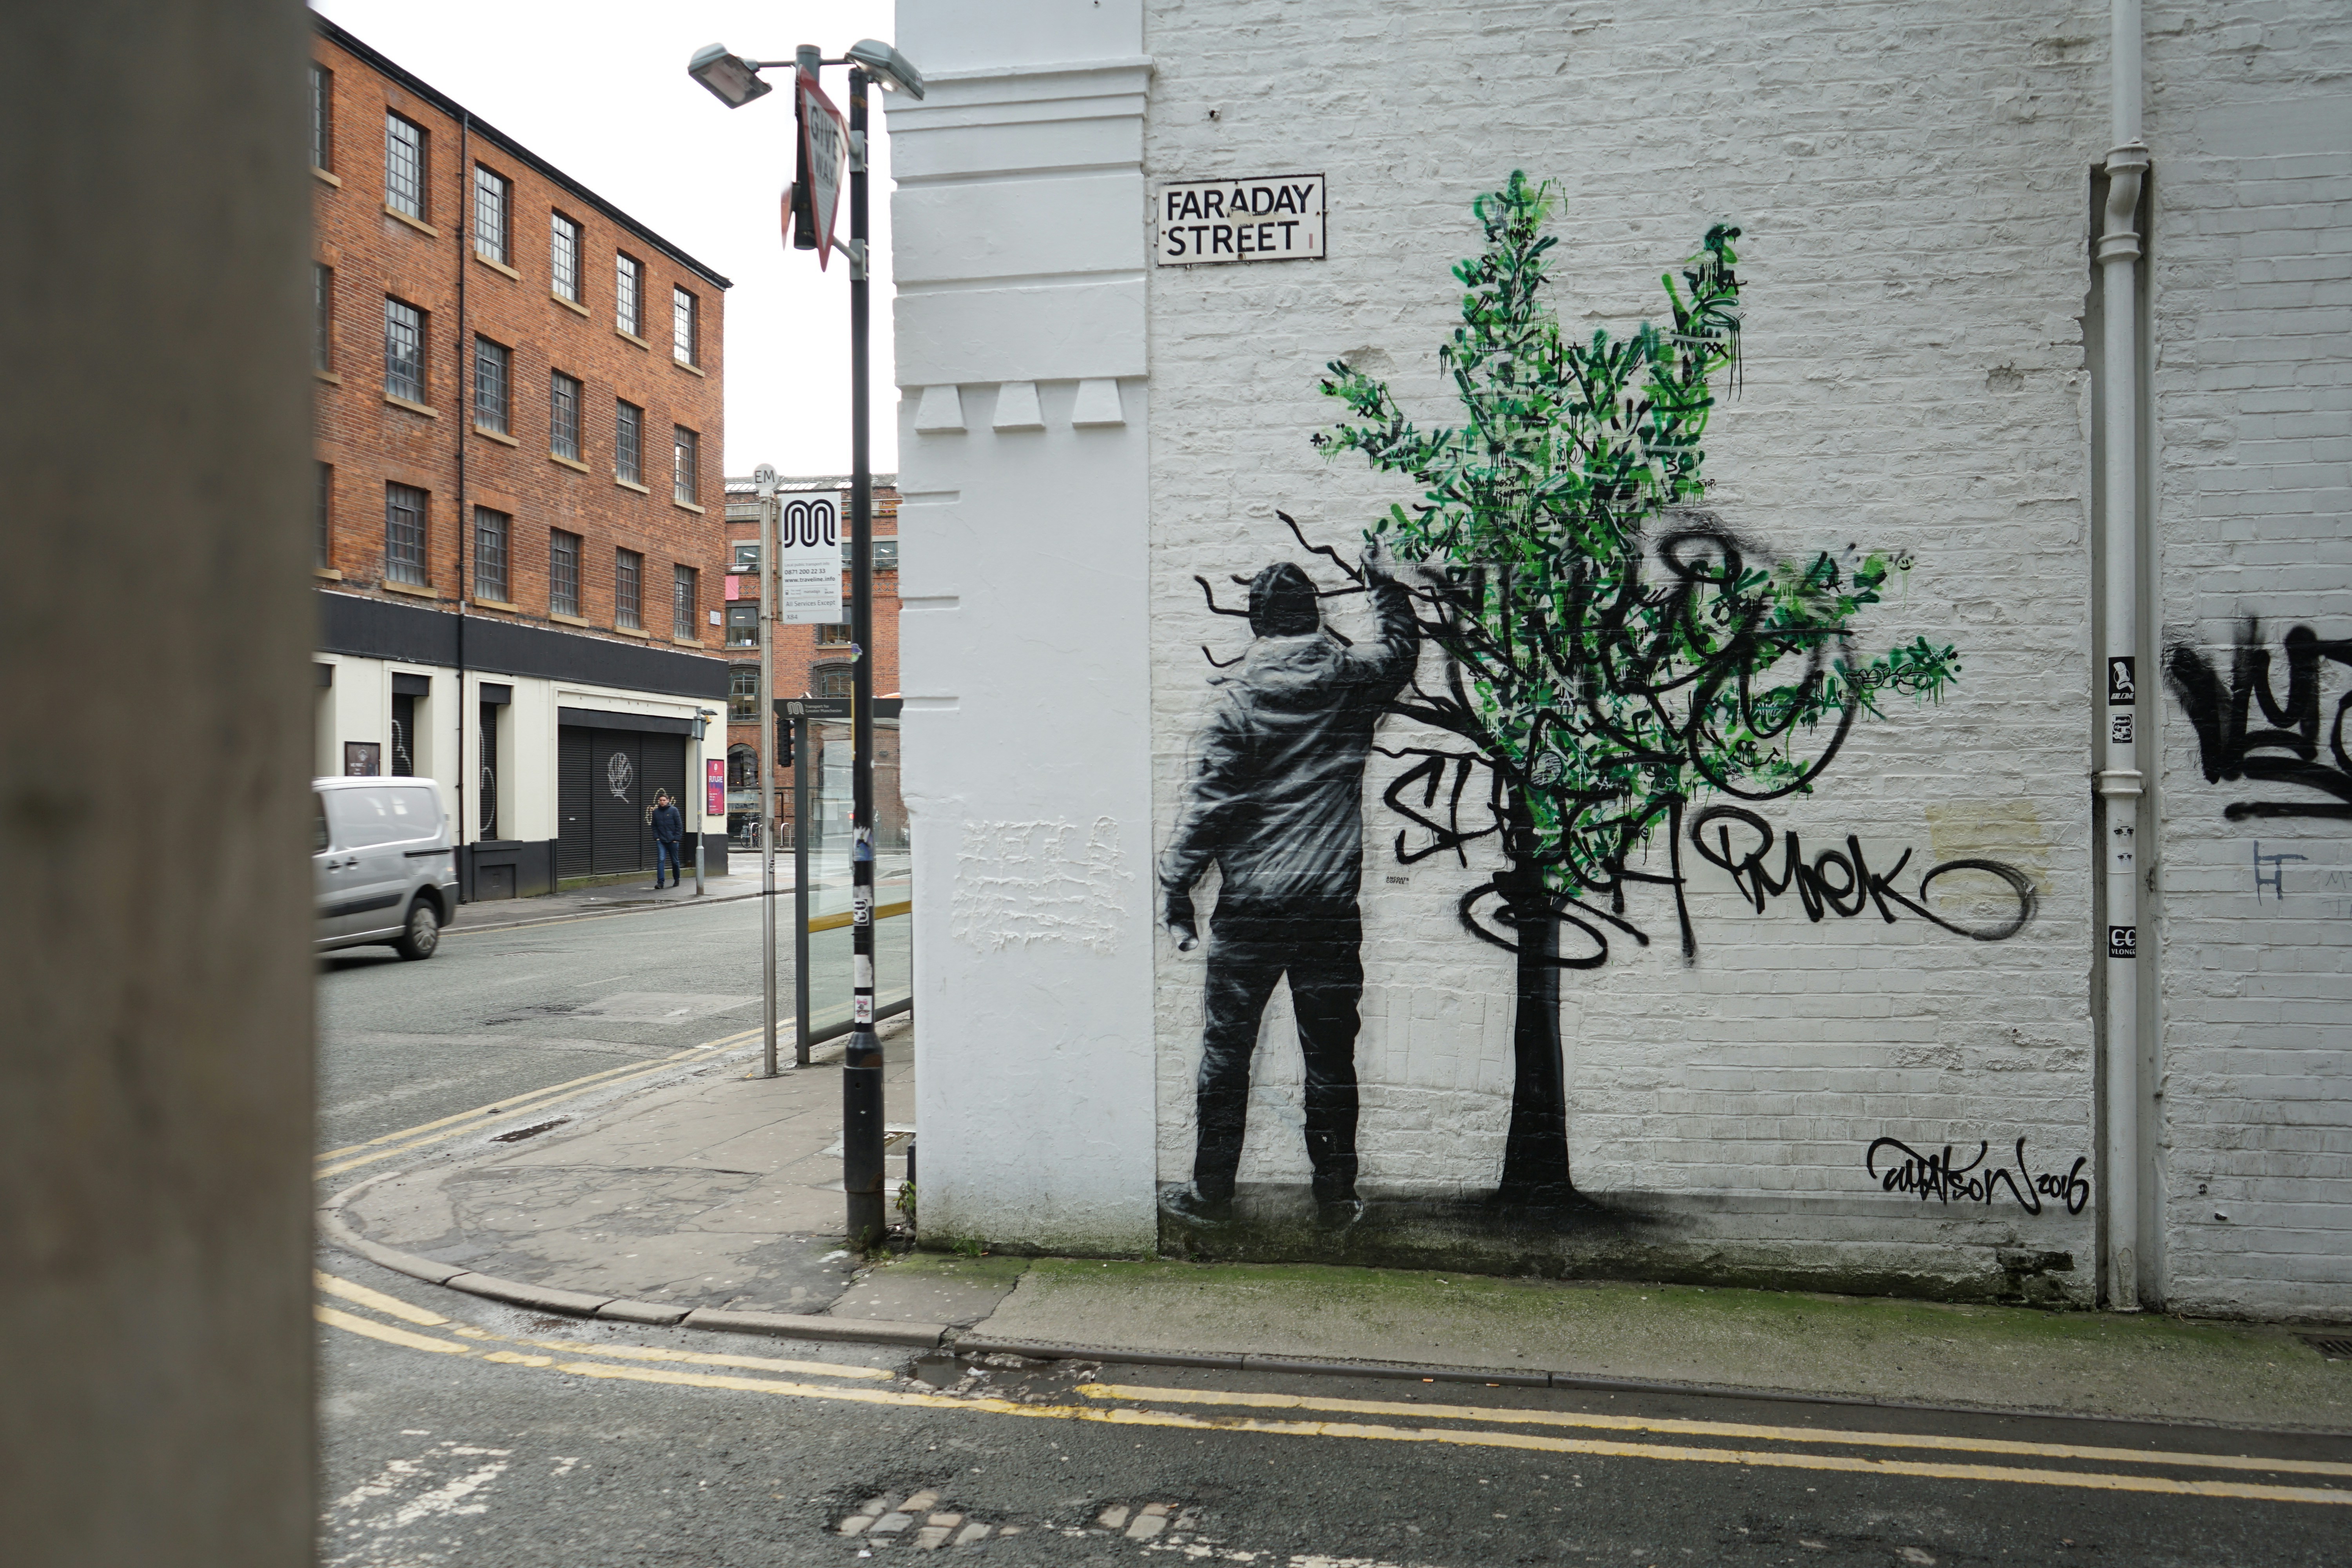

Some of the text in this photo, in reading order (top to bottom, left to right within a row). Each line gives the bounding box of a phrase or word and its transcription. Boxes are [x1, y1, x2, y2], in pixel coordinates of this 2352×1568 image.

[811, 106, 837, 162] GIVE
[815, 150, 834, 187] WAY
[1168, 184, 1314, 221] FARADAY
[1167, 220, 1299, 256] STREET
[755, 470, 775, 483] EM
[2035, 1156, 2089, 1215] 2016
